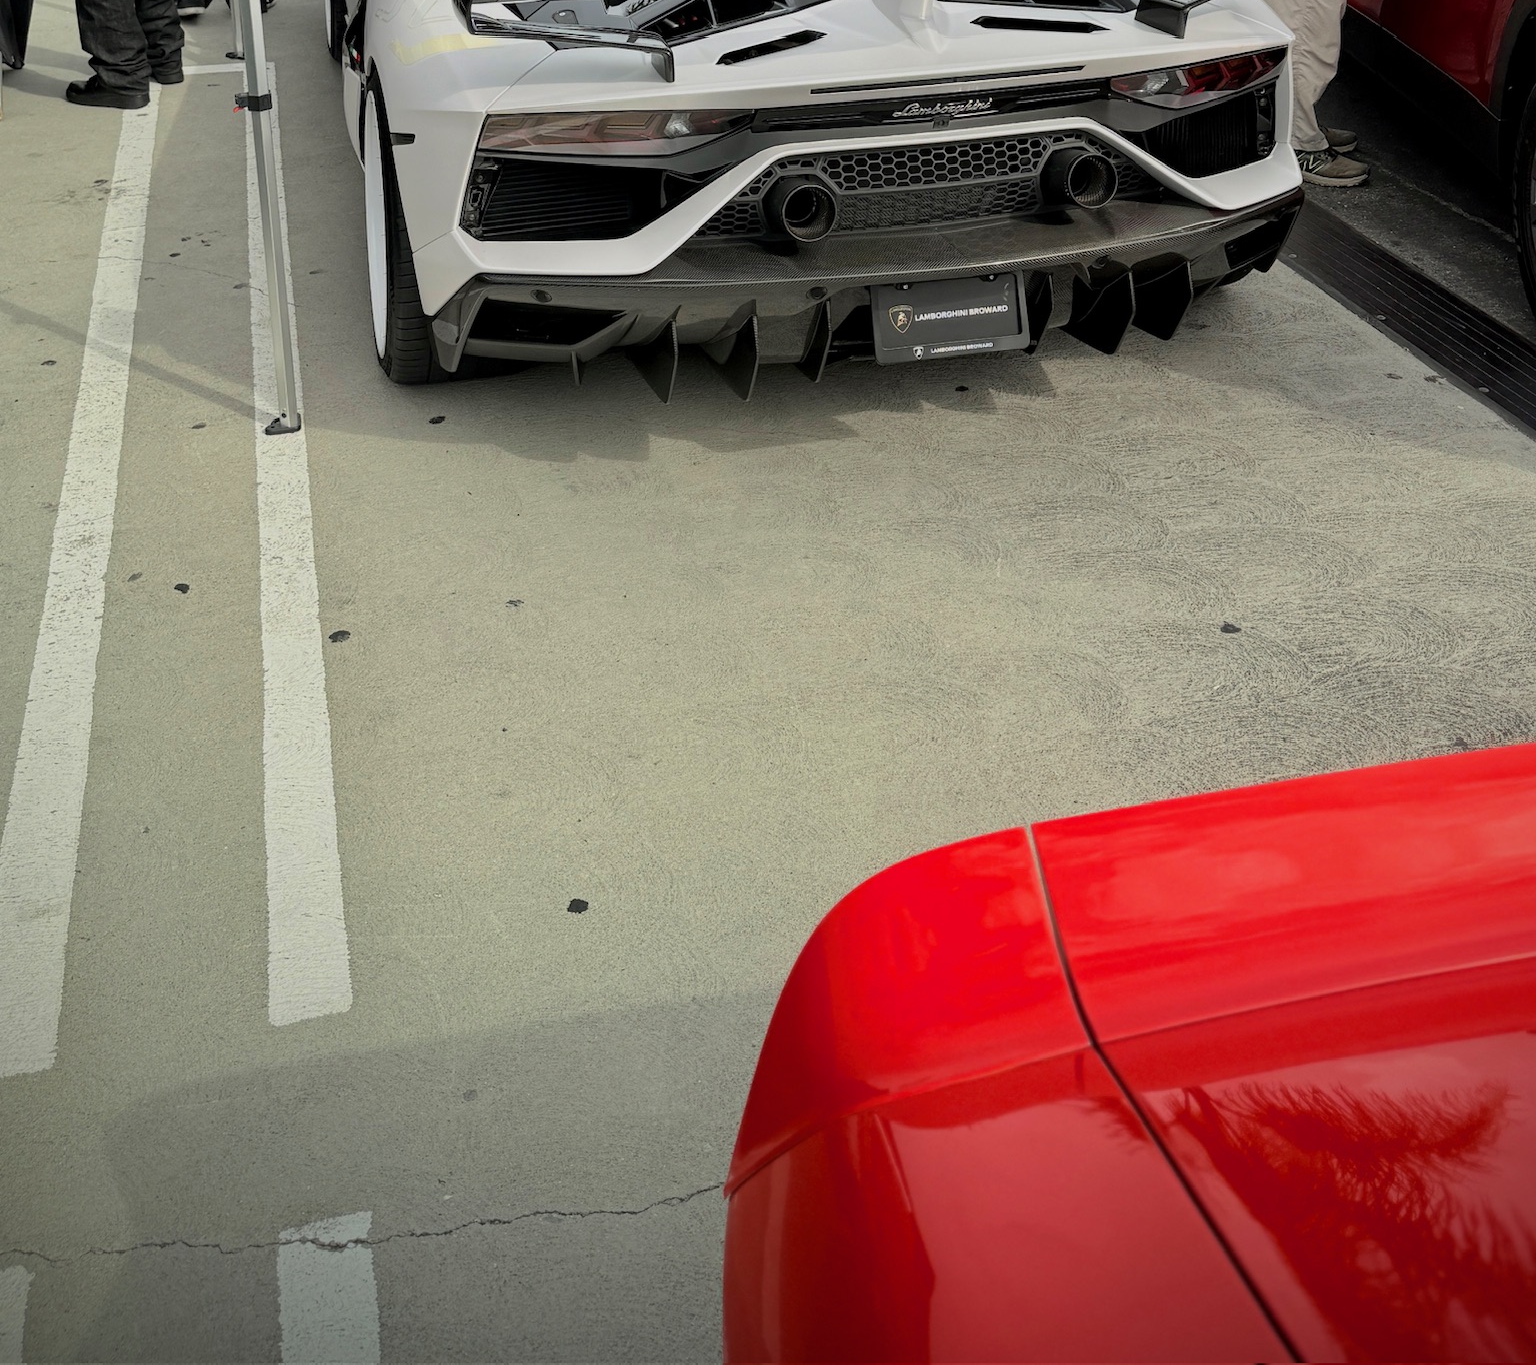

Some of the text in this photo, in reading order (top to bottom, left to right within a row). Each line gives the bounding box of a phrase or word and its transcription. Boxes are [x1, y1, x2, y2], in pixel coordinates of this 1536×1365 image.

[892, 97, 993, 117] Lamborghini
[914, 304, 1009, 322] LAMBORGHINI BROWARD
[930, 341, 994, 354] LAMBORGHINI BROWARD
